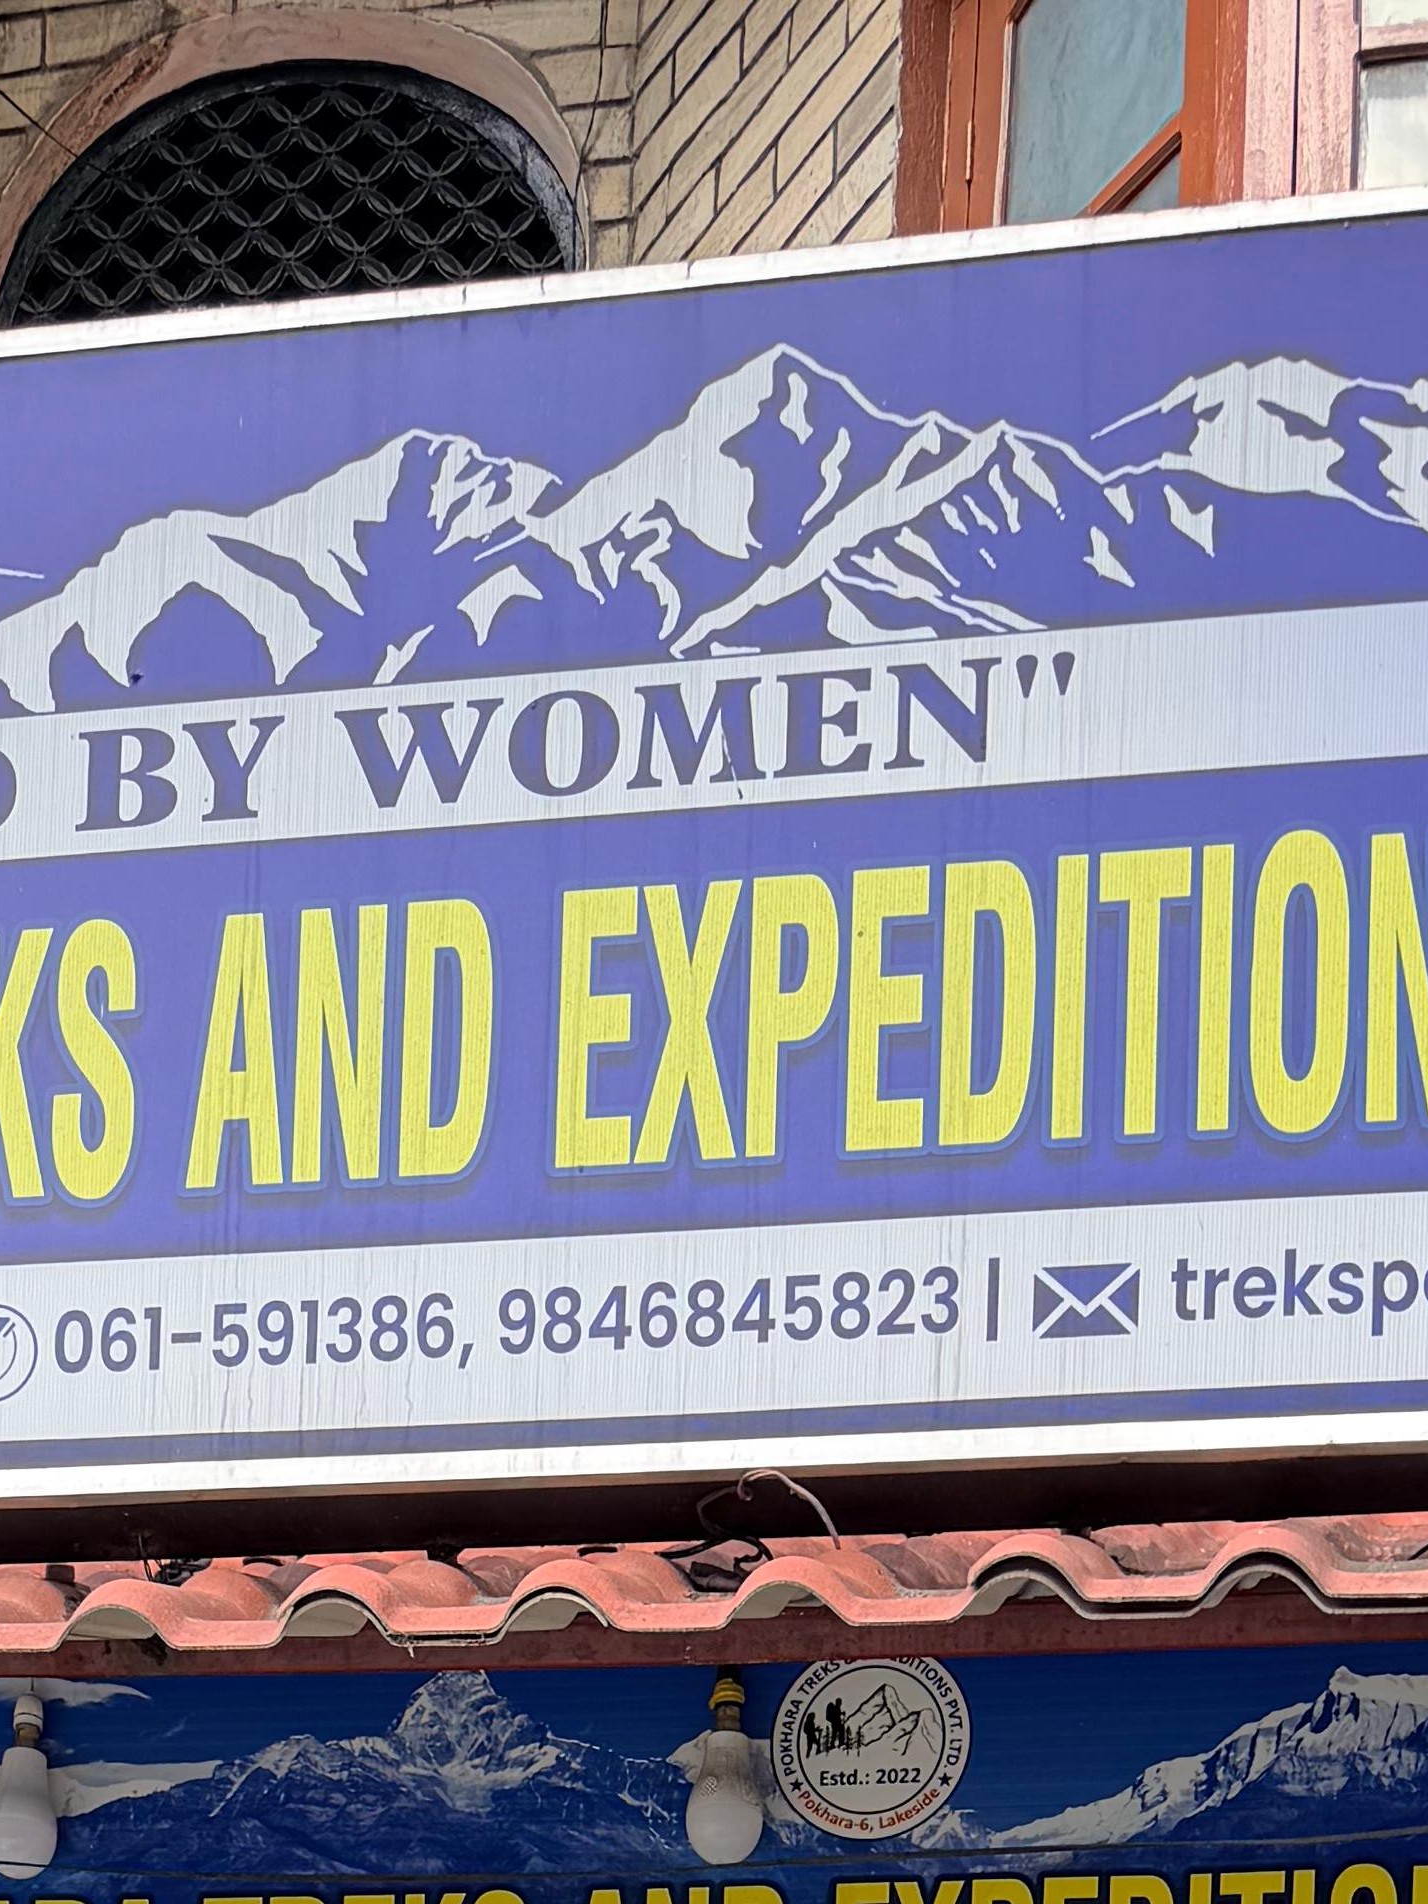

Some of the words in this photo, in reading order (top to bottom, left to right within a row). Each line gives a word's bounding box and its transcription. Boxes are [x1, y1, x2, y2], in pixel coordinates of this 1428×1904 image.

[75, 714, 286, 831] BY
[184, 898, 491, 1188] AND
[52, 1297, 477, 1378] 061-591386,
[497, 1262, 960, 1355] 9846845823
[796, 1658, 840, 1699] TREKS
[780, 1700, 803, 1776] POKHARA
[945, 1699, 963, 1733] PVT.
[943, 1738, 963, 1768] LTD.
[819, 1769, 870, 1787] Estd.:
[875, 1767, 921, 1785] 2022
[799, 1790, 874, 1833] Pokhara-6,
[878, 1788, 941, 1830] Lakeside
